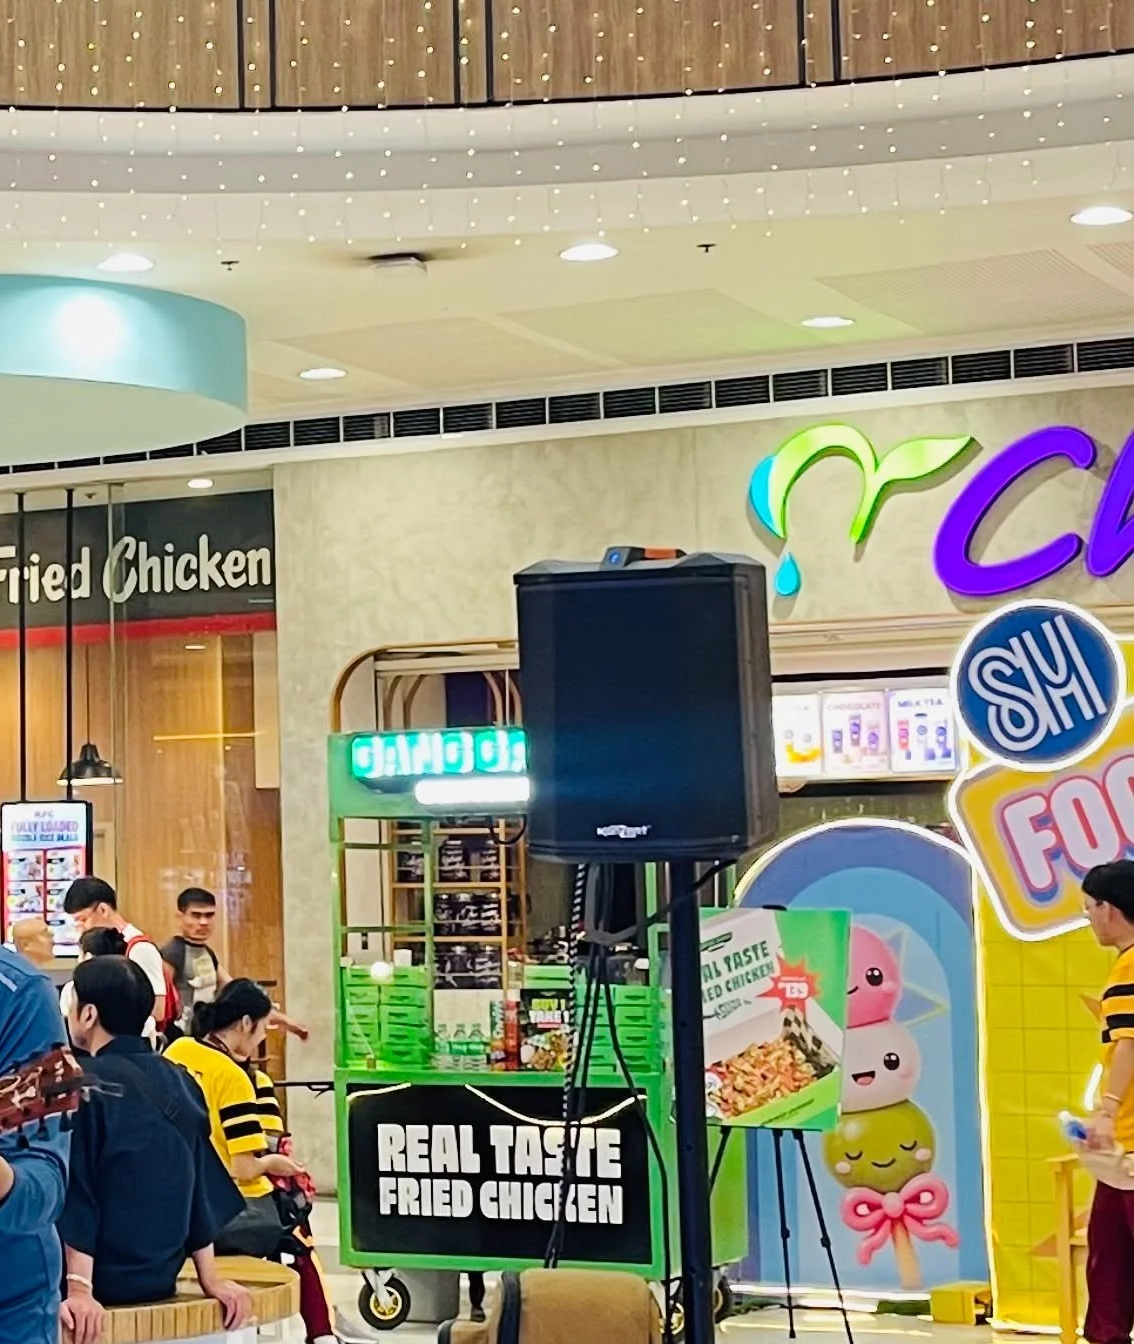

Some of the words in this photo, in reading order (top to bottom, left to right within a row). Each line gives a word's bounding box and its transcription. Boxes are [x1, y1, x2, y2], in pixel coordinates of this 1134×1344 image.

[103, 534, 272, 604] Chicken
[968, 613, 1108, 753] SM
[10, 821, 38, 833] FULLY
[40, 820, 79, 833] LOADED
[723, 940, 771, 974] TASTE
[725, 960, 776, 993] CHICKEN
[377, 1123, 481, 1174] REAL
[489, 1124, 622, 1179] TASTE
[378, 1176, 474, 1218] FRIED
[479, 1180, 624, 1225] CHICKEN
